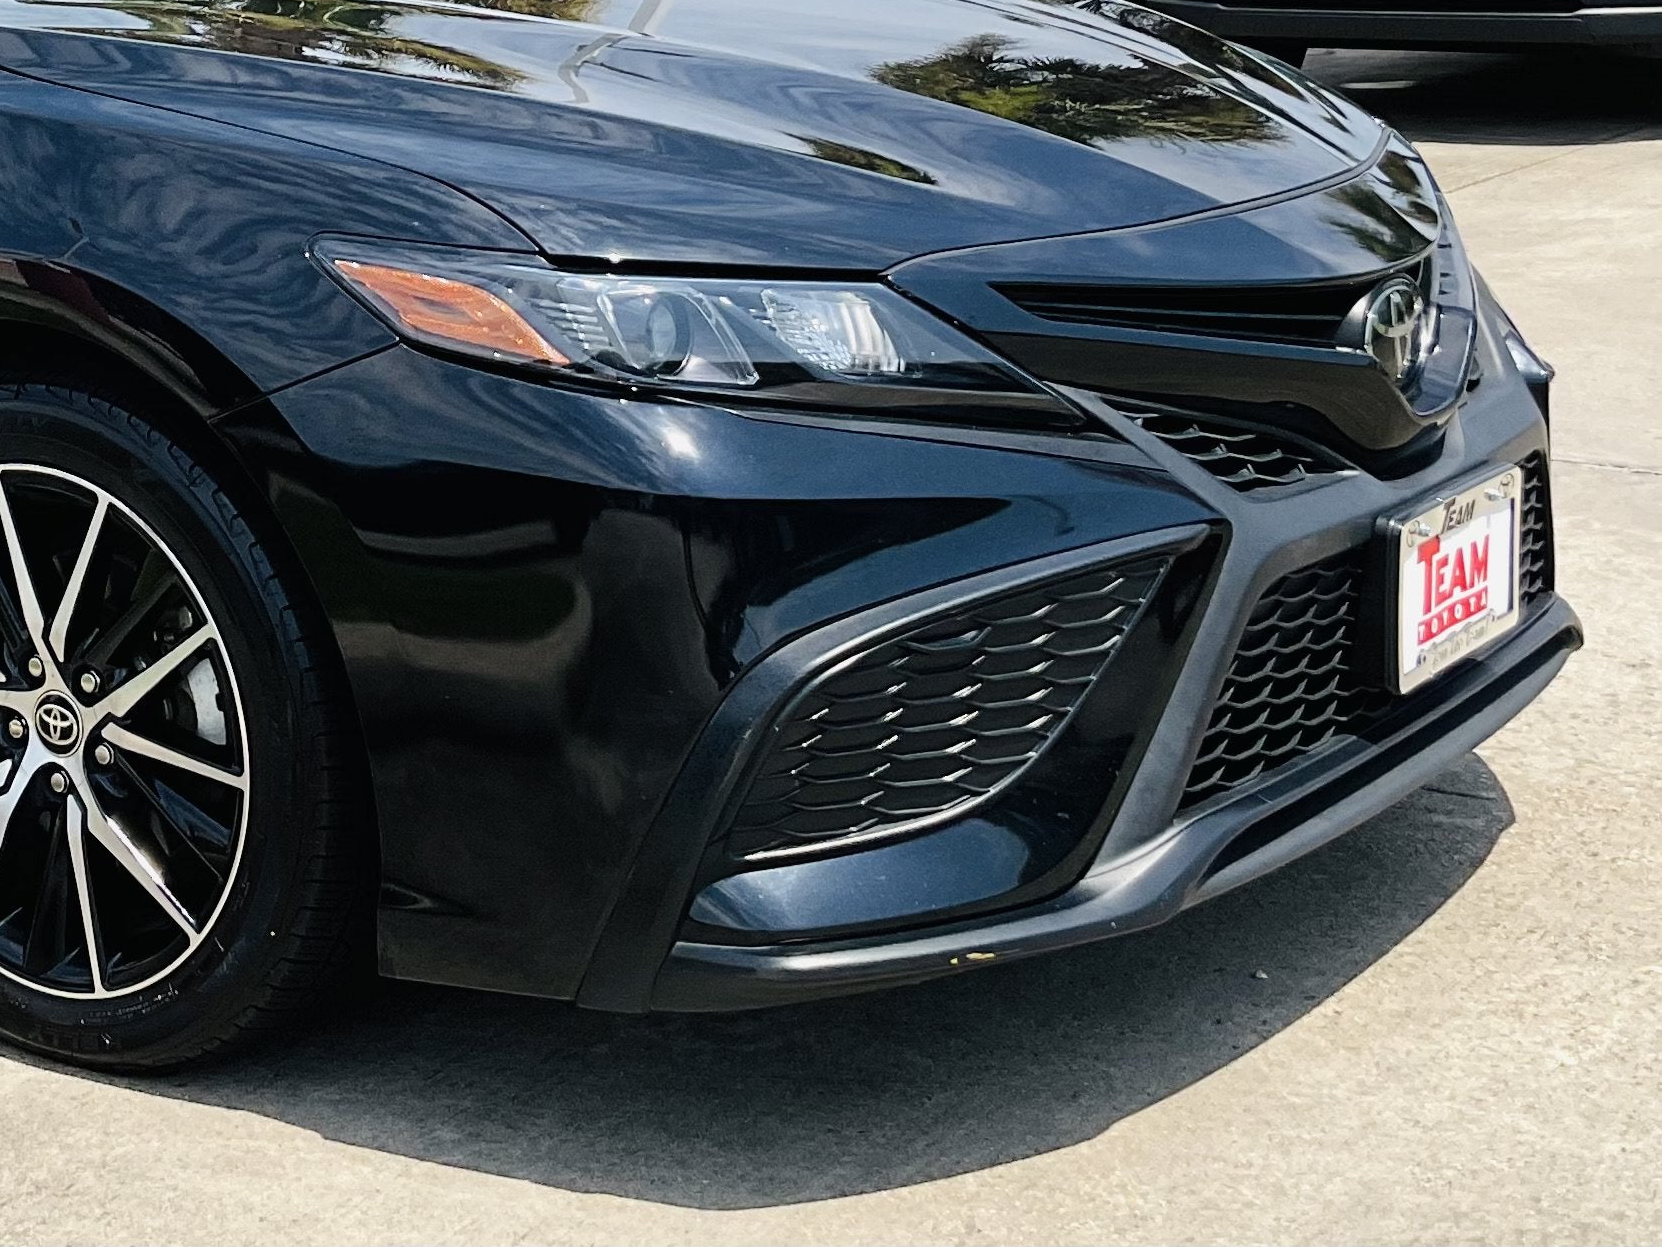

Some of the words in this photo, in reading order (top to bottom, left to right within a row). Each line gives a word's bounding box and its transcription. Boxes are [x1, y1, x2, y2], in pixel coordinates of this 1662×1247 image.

[1441, 497, 1476, 534] TEAM
[1417, 534, 1490, 616] TEAM
[1418, 590, 1488, 642] TOYOTA
